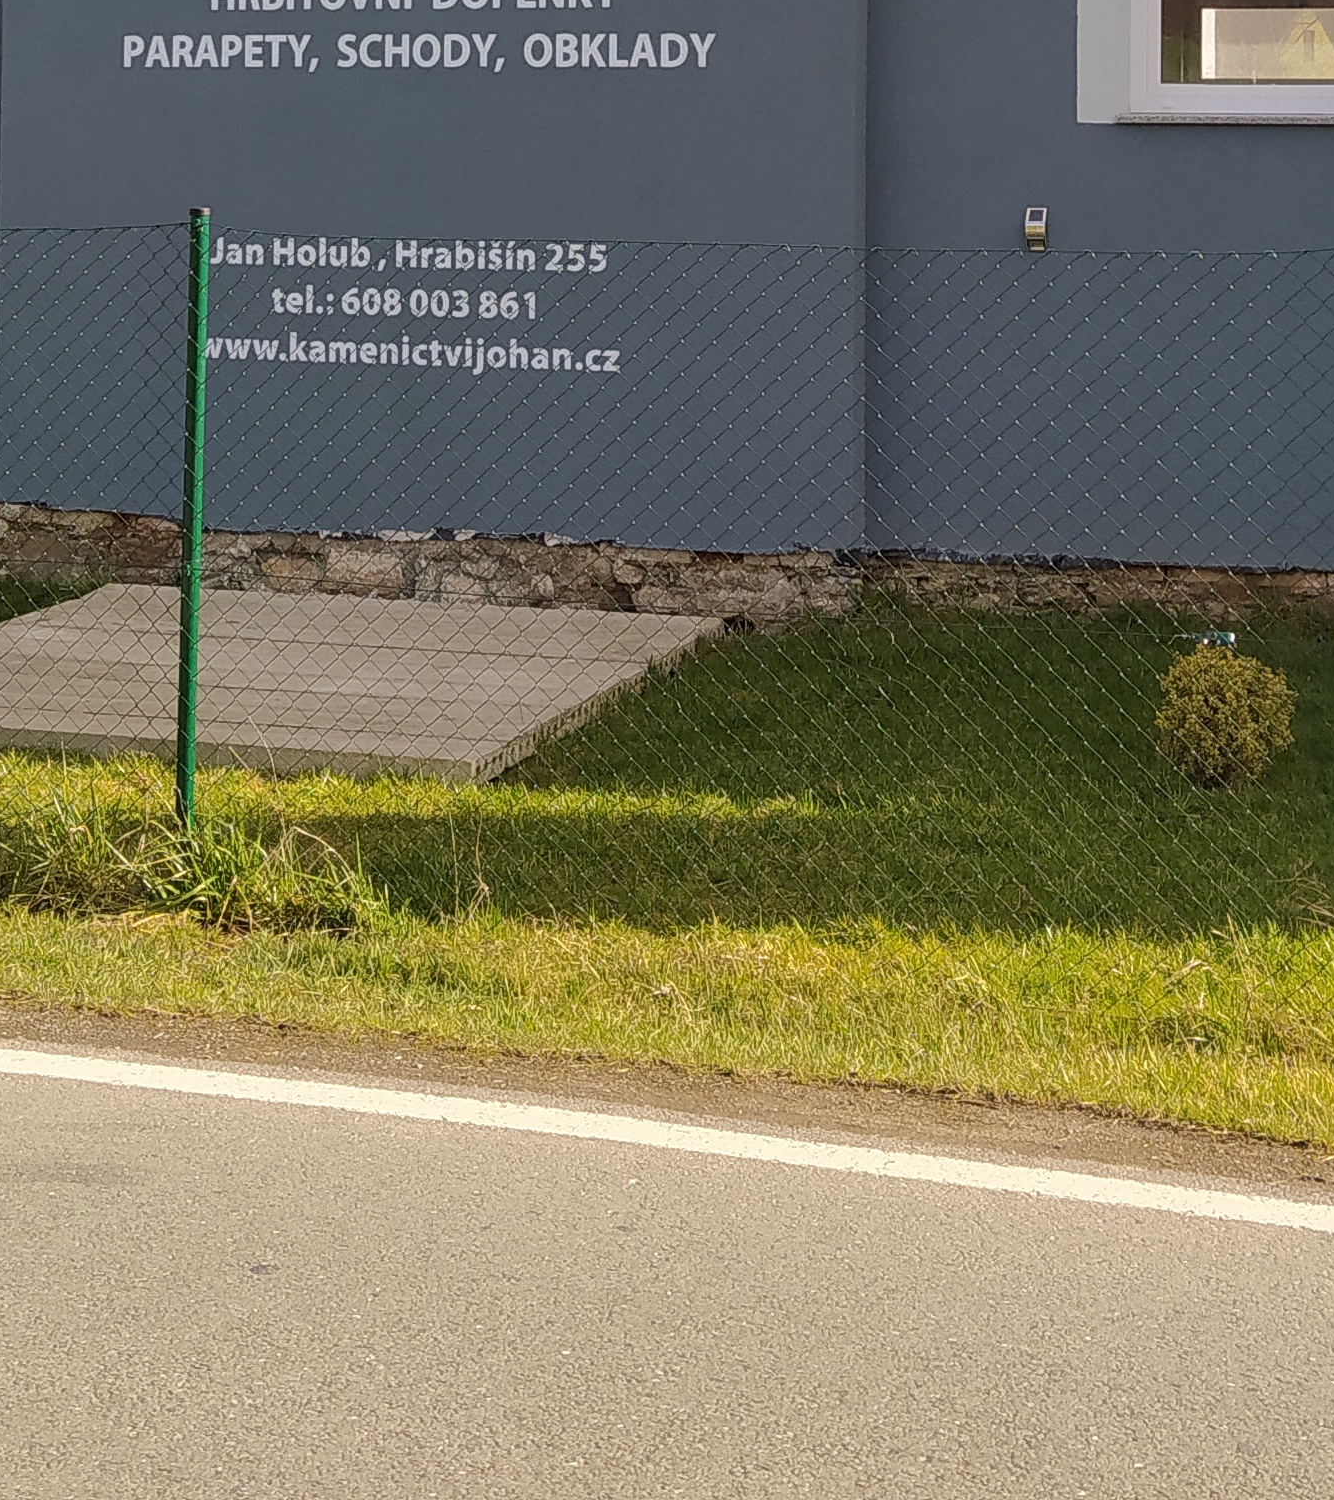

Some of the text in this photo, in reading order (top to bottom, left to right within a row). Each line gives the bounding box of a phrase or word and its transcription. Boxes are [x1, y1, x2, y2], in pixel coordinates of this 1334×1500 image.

[124, 32, 716, 73] PARAPETY, SCHODY, OBKLADY
[209, 238, 265, 266] Jan
[395, 240, 536, 271] Hrabišín
[545, 243, 607, 273] 255
[272, 285, 536, 320] tel.: 608 003 861
[205, 332, 621, 375] www.kamenictvijohan.cz
